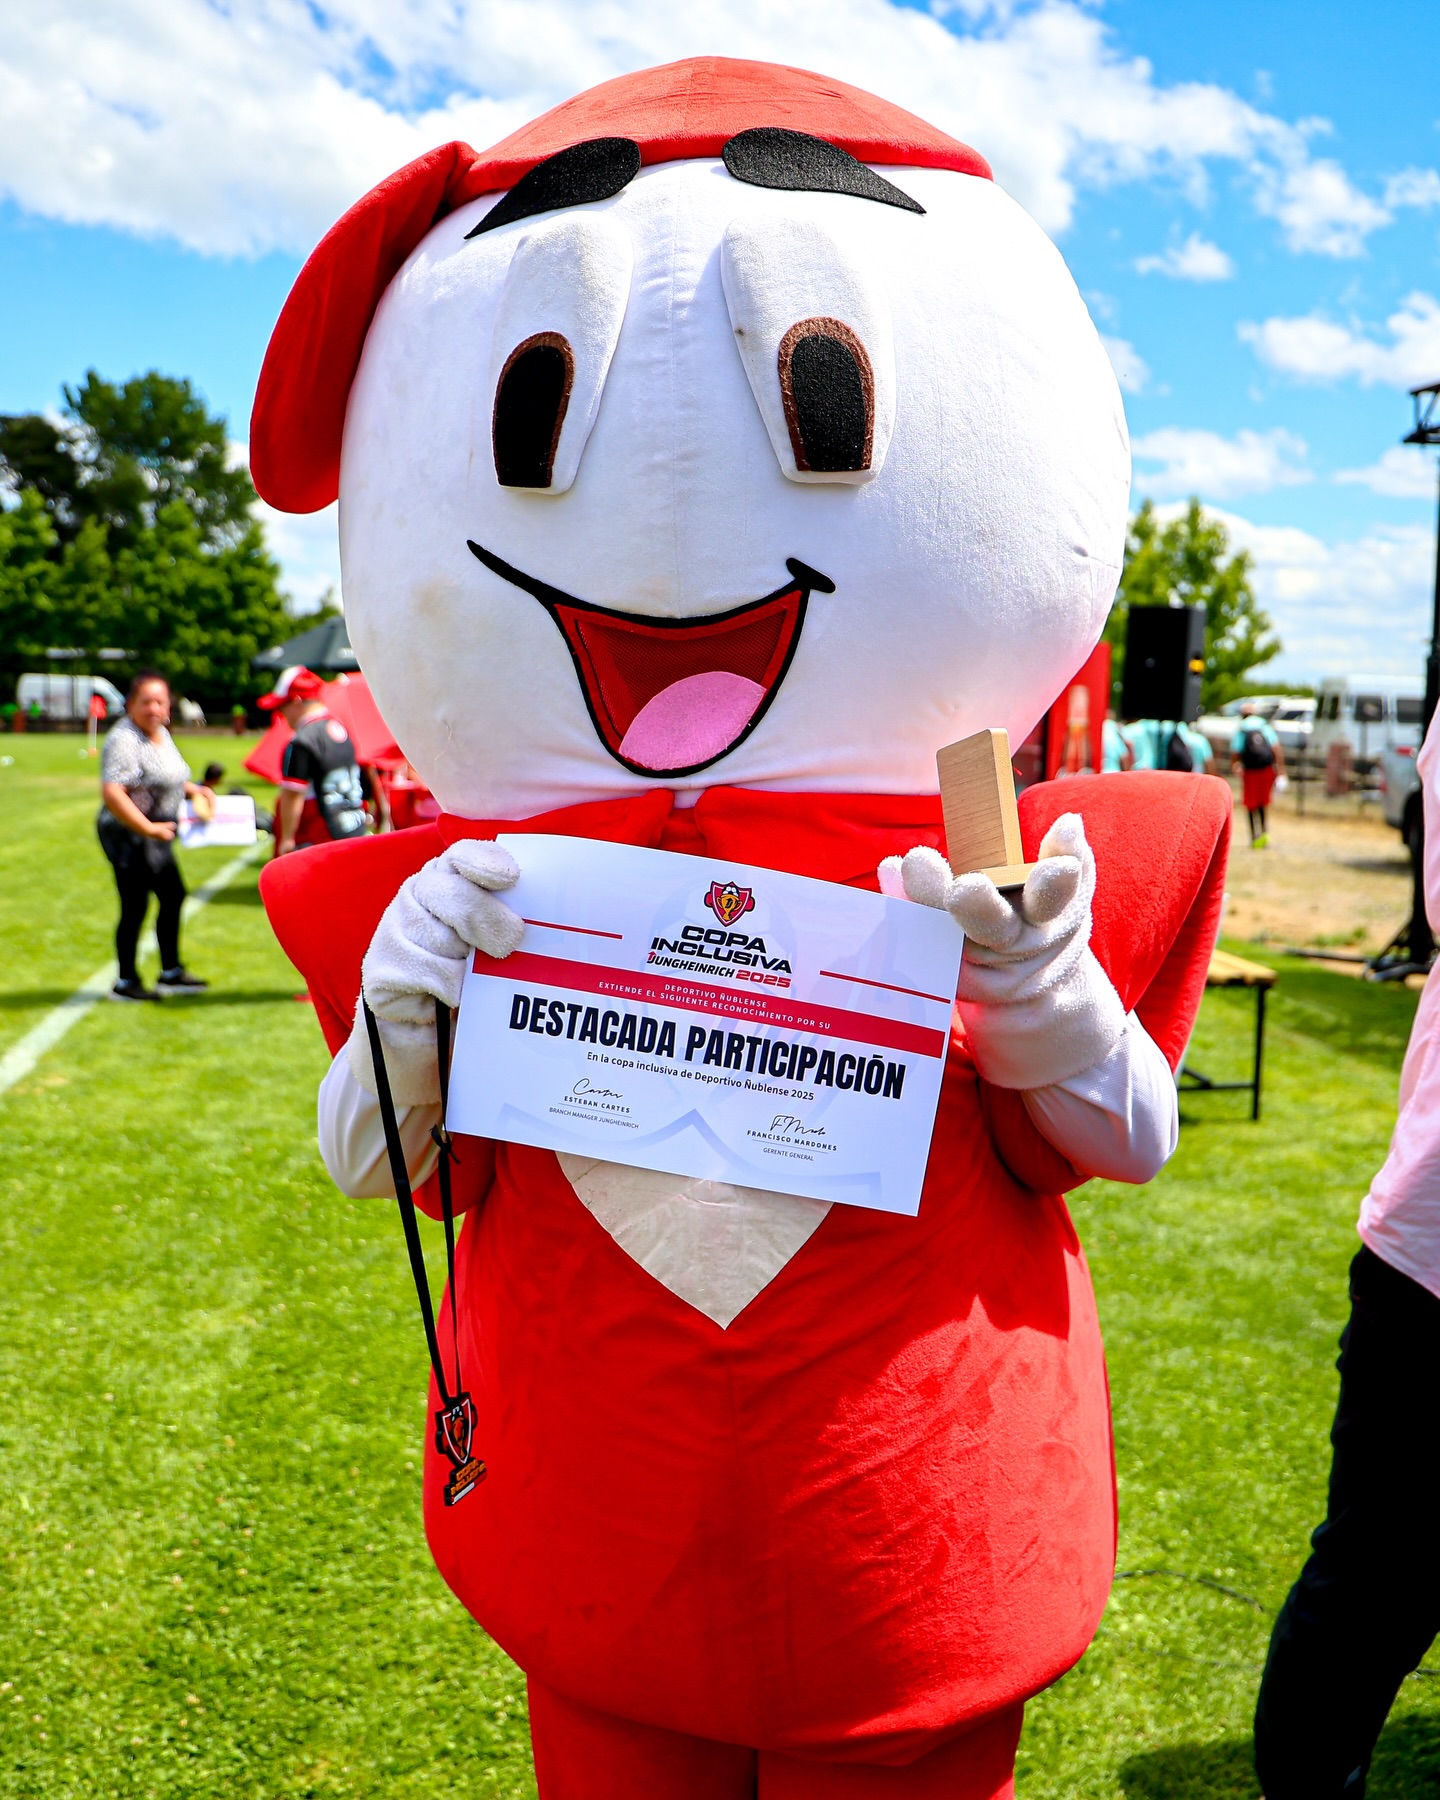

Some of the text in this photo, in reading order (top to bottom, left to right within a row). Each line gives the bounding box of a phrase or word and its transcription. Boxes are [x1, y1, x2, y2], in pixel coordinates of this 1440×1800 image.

[681, 925, 767, 954] COPA
[650, 936, 792, 974] INCLUSIVA
[646, 951, 792, 989] JUNGHEINRICH 2025
[598, 981, 831, 1030] EXTIENDE EL SIGUIENTE RECONOCIMIENTO POR SU
[664, 983, 768, 1009] DEPORTIVO ÑUBLENSE
[509, 993, 907, 1100] DESTACADA PARTICIPACIÓN
[587, 1051, 815, 1101] En la copa inclusiva de Deportivo Ñublense 2025
[549, 1107, 639, 1130] BRANCH MANAGER JUNGHEINRICH
[564, 1095, 631, 1114] ESTEBAN CARTES
[747, 1130, 838, 1152] FRANCISCO MARDONES
[763, 1147, 815, 1162] GERENTE GENERAL
